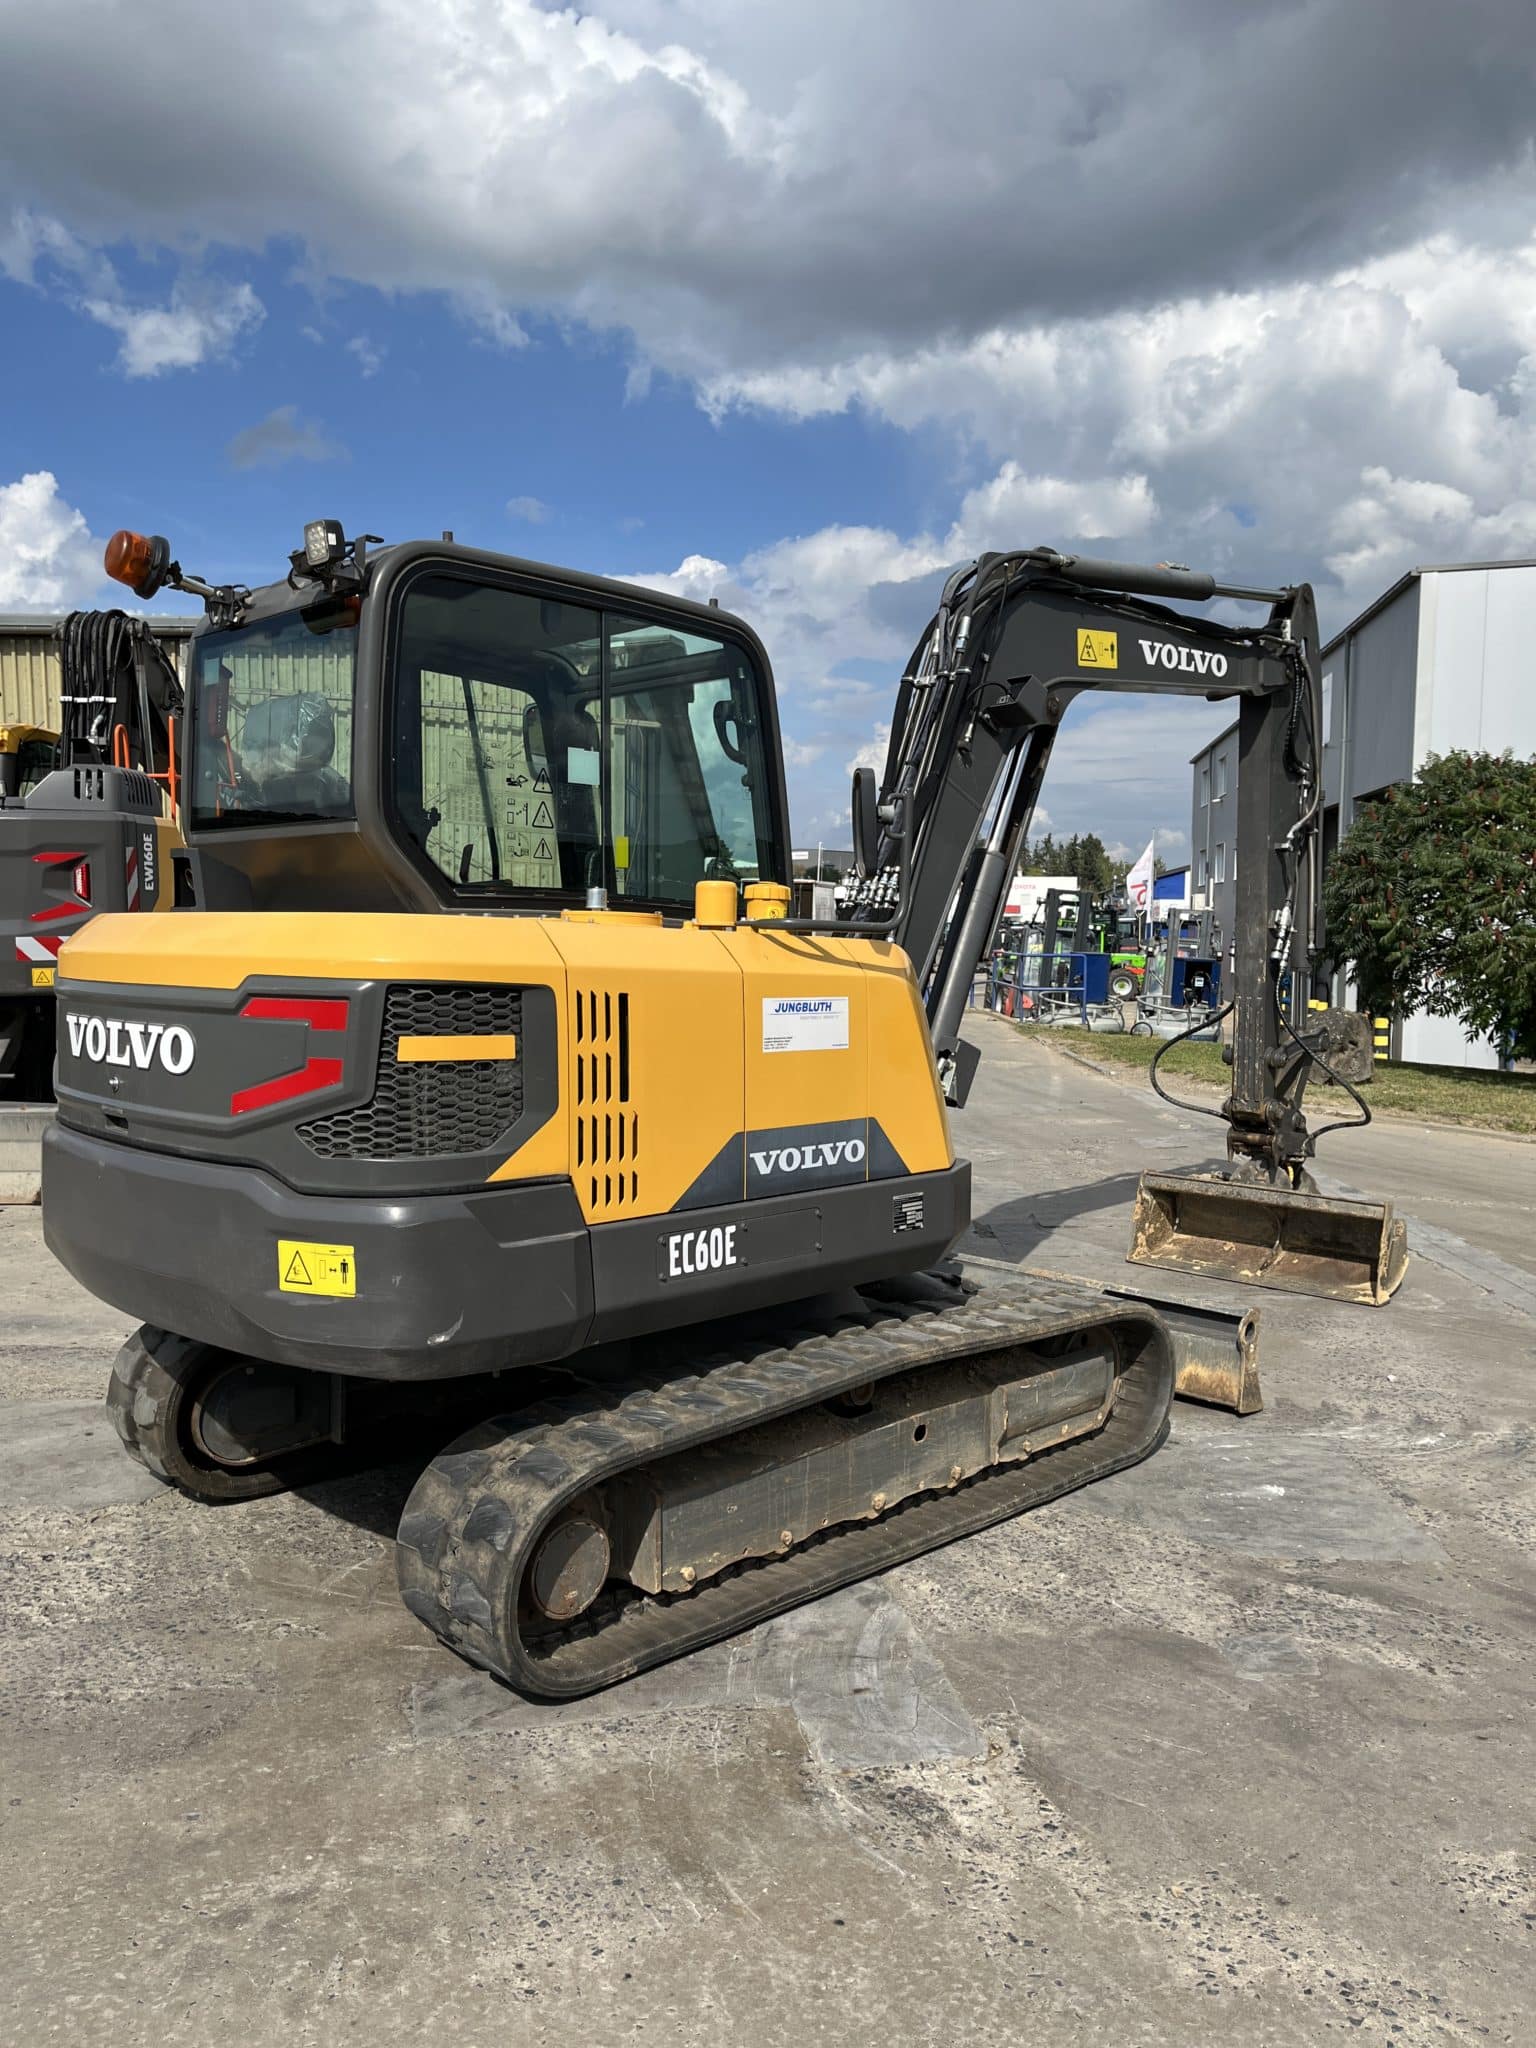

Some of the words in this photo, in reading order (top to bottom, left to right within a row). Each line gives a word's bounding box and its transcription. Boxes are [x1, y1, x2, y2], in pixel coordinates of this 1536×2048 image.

[1138, 639, 1228, 678] VOLVO
[143, 833, 154, 891] EW160E
[775, 1002, 832, 1013] JUNGBLUTH
[66, 1014, 195, 1075] VOLVO
[750, 1139, 865, 1176] VOLVO
[669, 1224, 737, 1277] EC60E
